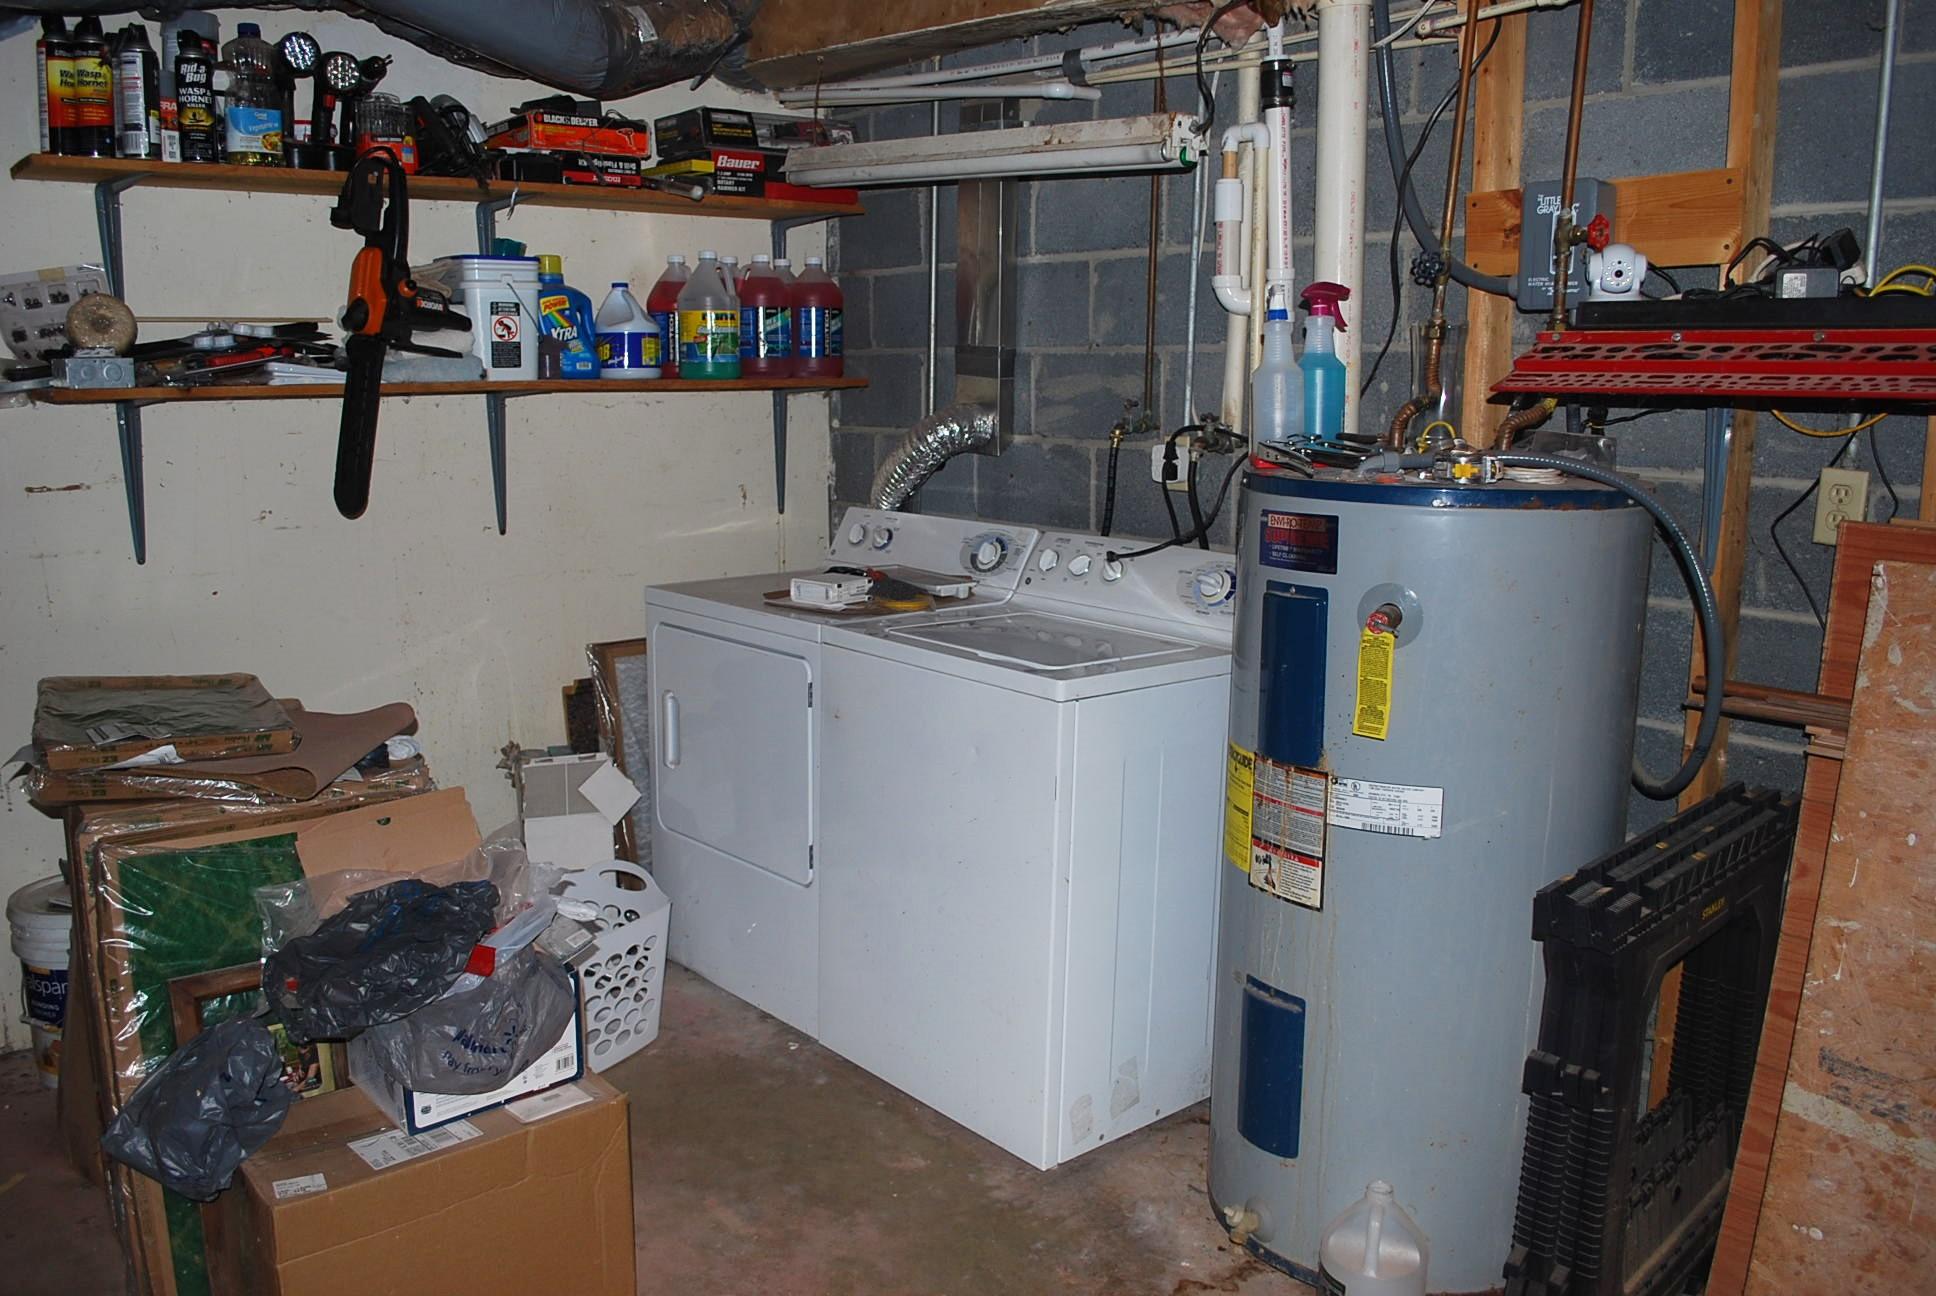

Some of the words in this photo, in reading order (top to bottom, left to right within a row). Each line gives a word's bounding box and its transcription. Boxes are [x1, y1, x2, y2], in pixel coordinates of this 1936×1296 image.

[179, 87, 206, 95] WASP
[178, 96, 213, 105] HORNET
[544, 114, 566, 125] BLACK
[717, 155, 760, 169] Bauer
[1540, 196, 1561, 206] LITTLE
[1536, 205, 1560, 215] GRAY
[551, 326, 578, 342] XTRA
